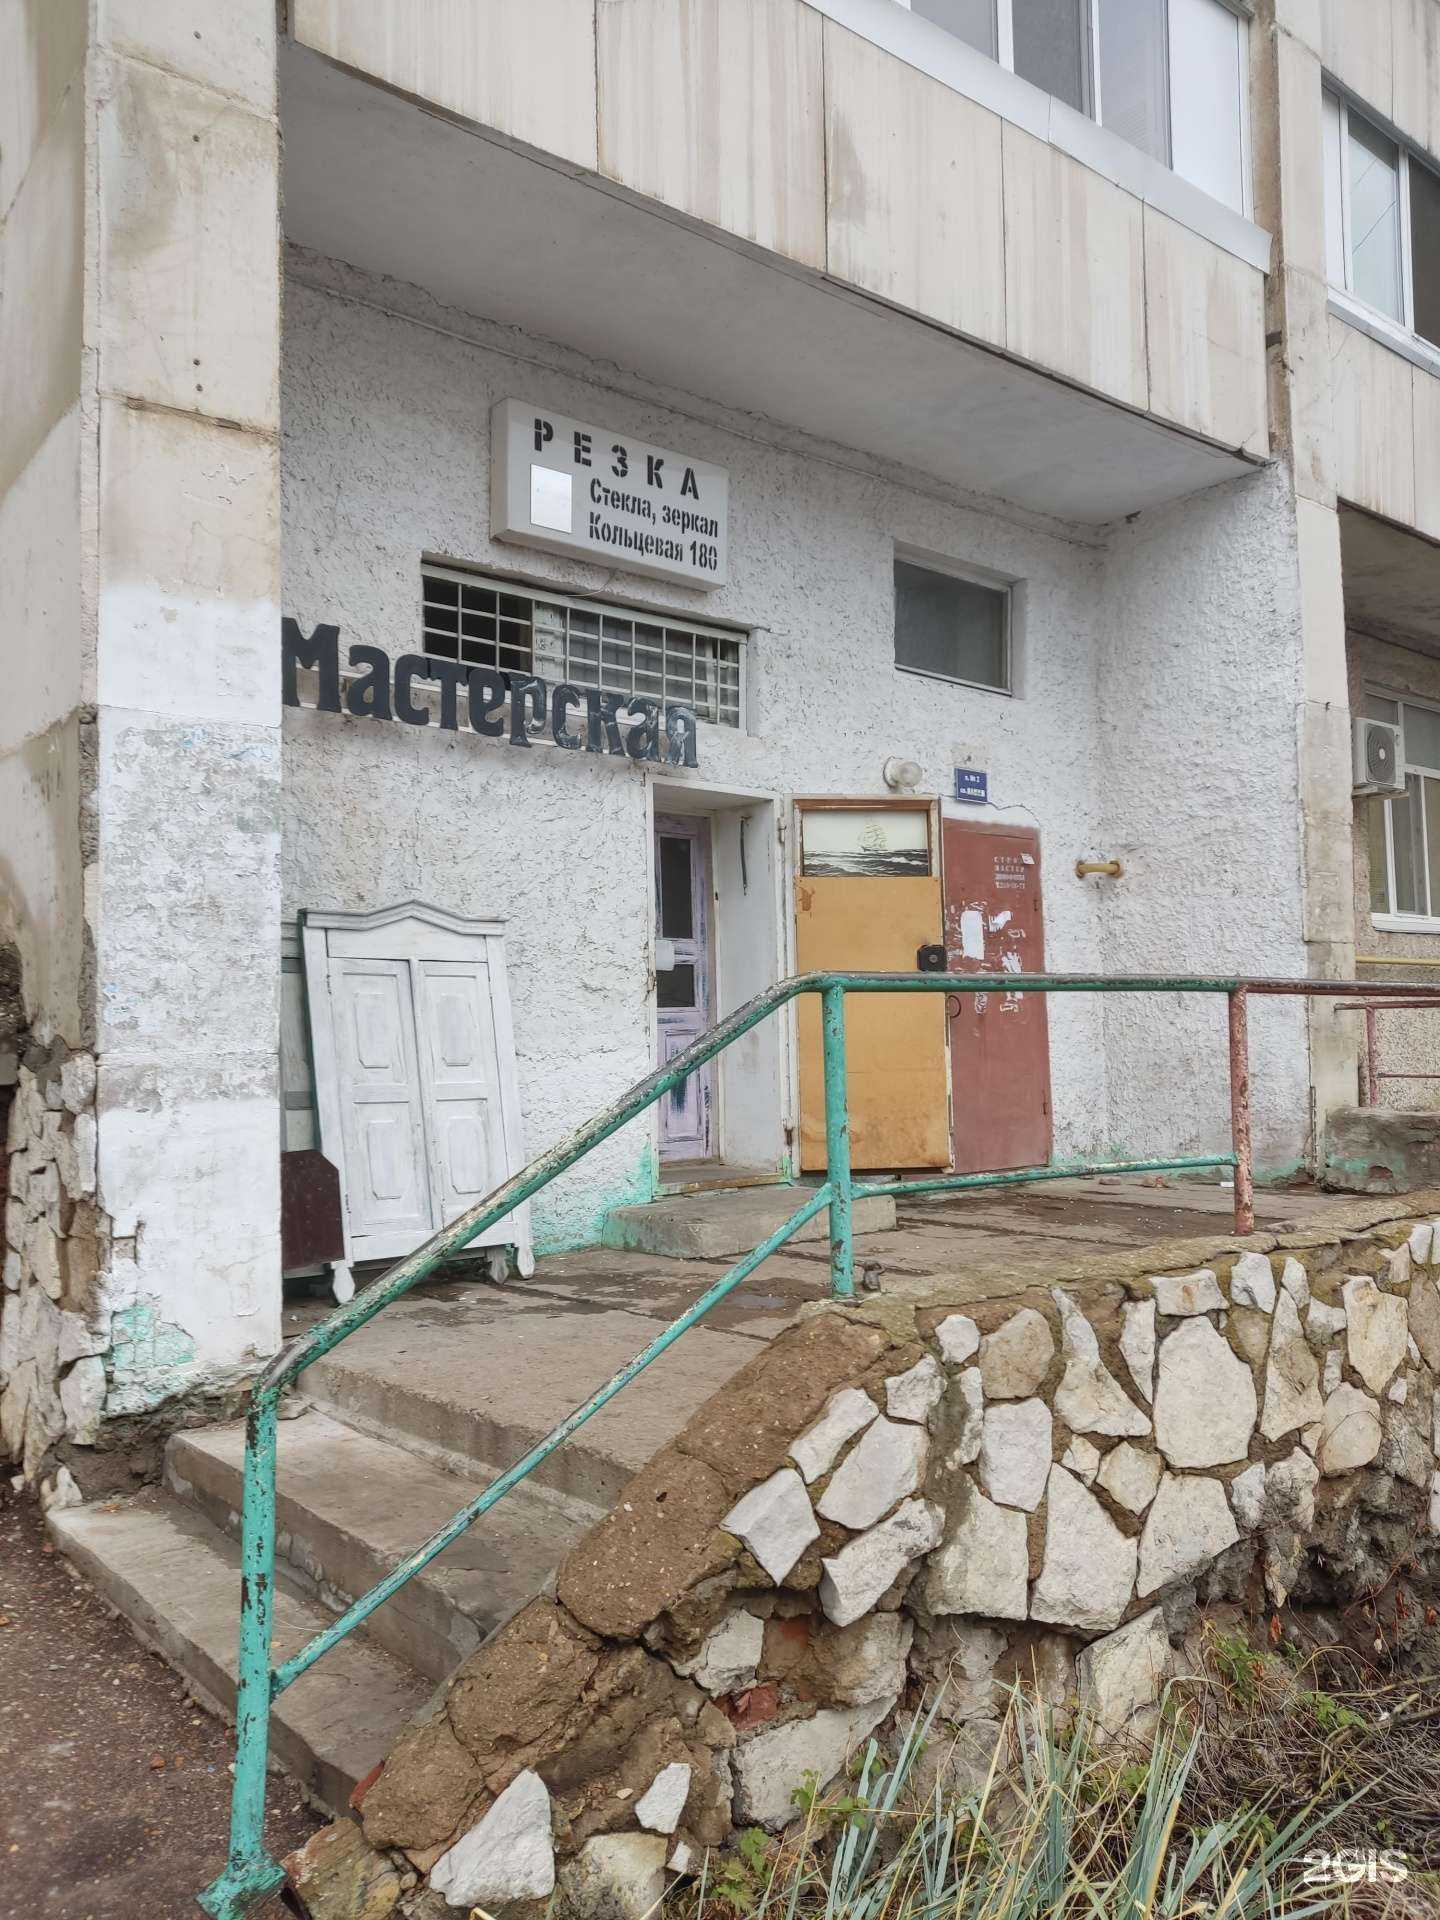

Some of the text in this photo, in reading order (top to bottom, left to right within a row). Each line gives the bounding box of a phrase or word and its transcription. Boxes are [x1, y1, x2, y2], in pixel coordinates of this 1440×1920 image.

[534, 418, 699, 500] РЕЗКА
[589, 511, 718, 571] Кольцевая 180
[590, 477, 718, 538] Стекла, зеркал
[281, 616, 699, 768] Мастерская
